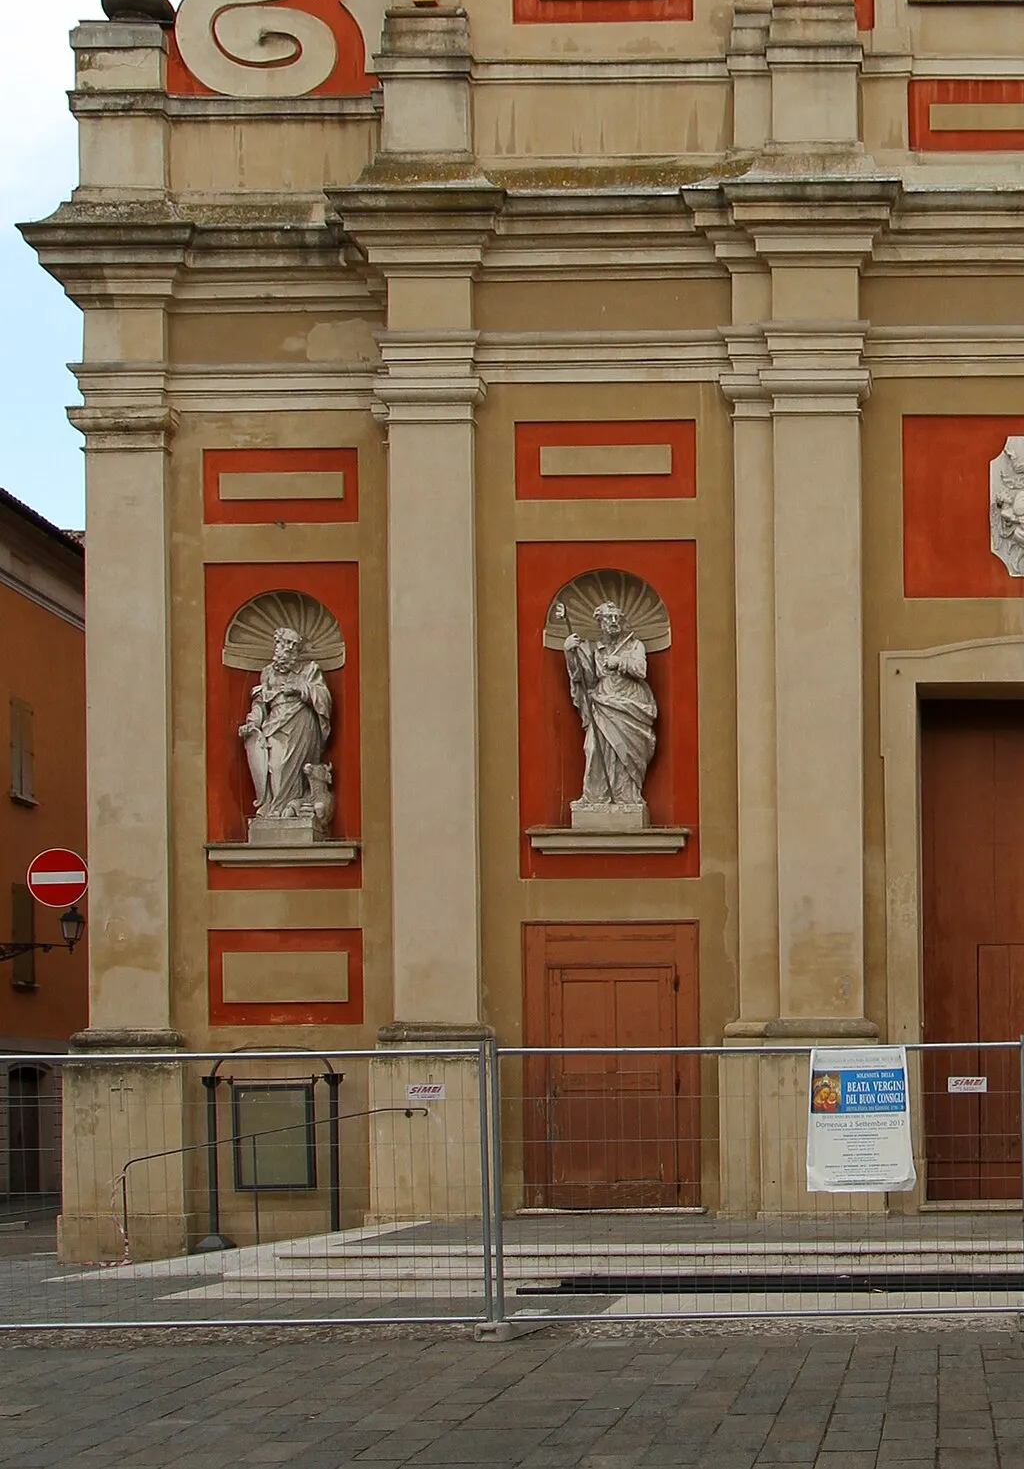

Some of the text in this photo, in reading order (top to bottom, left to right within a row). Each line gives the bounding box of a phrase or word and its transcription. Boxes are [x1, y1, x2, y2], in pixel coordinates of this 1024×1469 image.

[847, 1081, 871, 1092] BEATA
[846, 1094, 858, 1105] DEL
[859, 1093, 876, 1104] BUON
